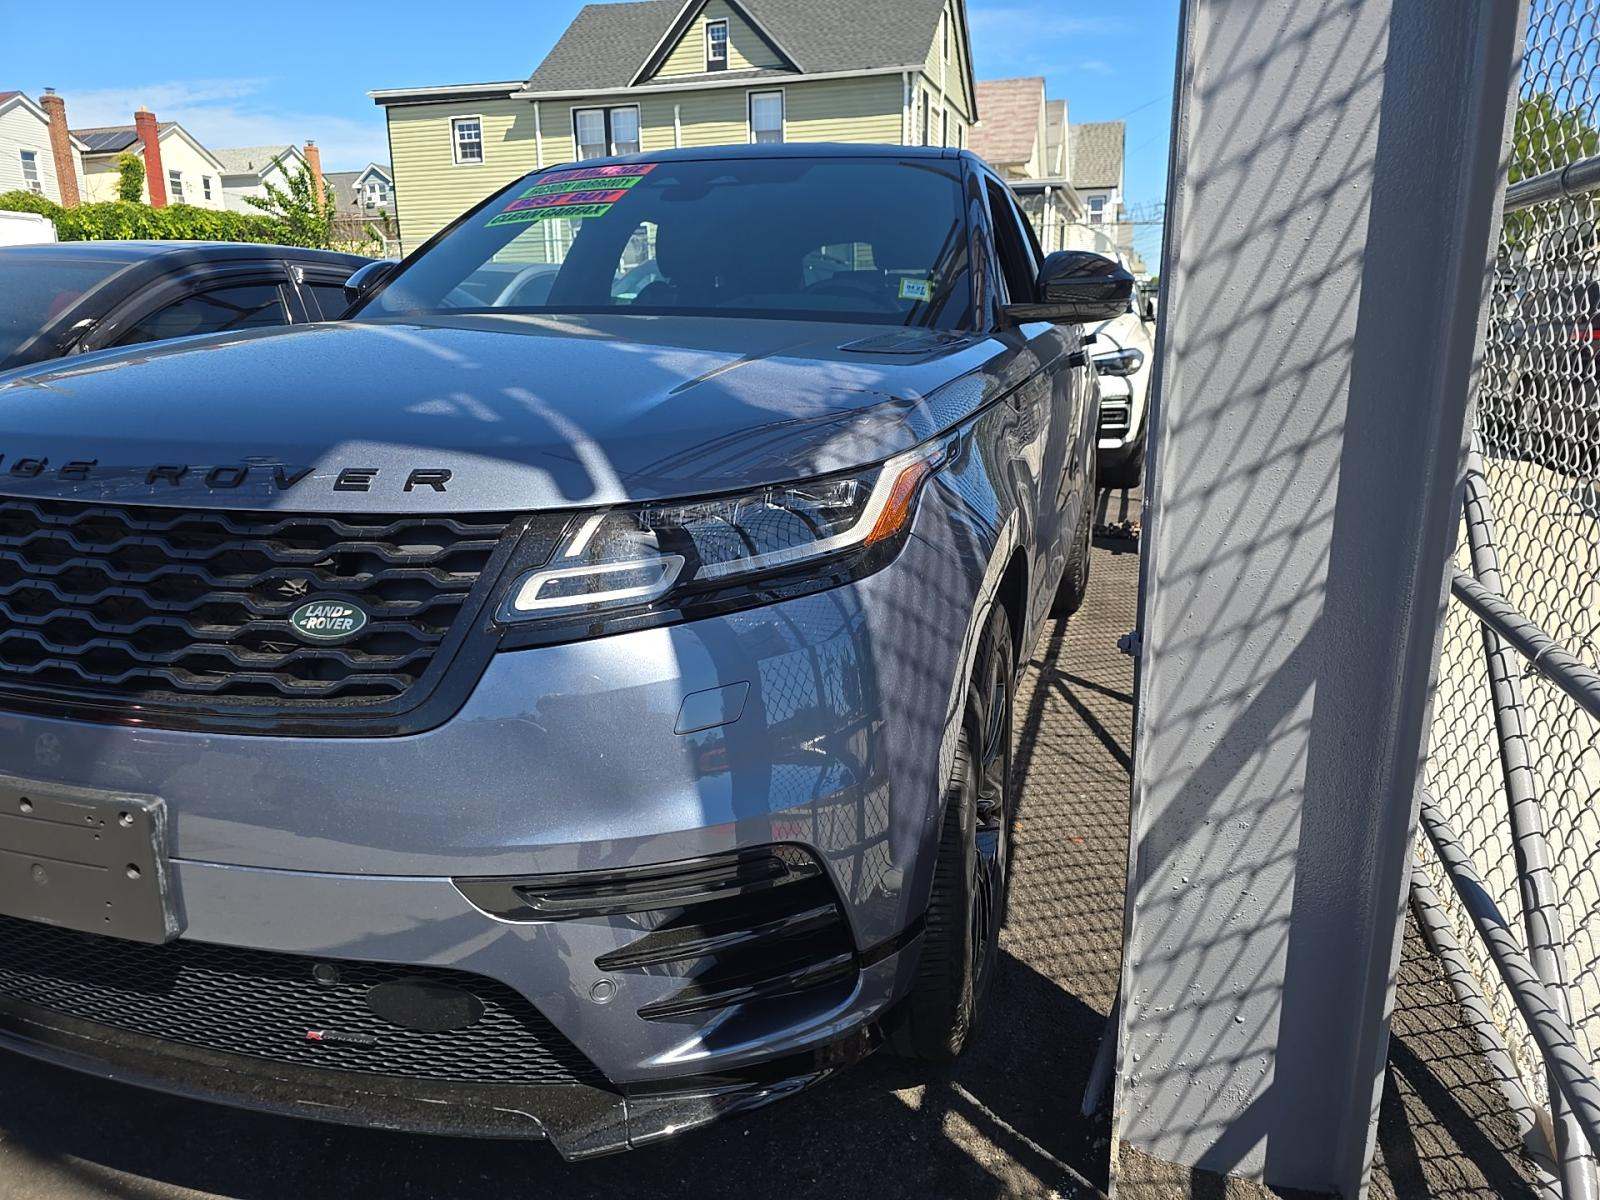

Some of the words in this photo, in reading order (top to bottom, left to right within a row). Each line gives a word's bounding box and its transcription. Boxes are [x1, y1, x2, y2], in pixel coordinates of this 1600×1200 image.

[513, 194, 566, 210] BEST
[567, 191, 617, 203] BUY
[490, 210, 538, 225] CLEAN
[539, 204, 610, 219] CARFAX
[144, 463, 454, 492] ROVER
[305, 605, 343, 617] LAND
[306, 617, 353, 630] ROVER
